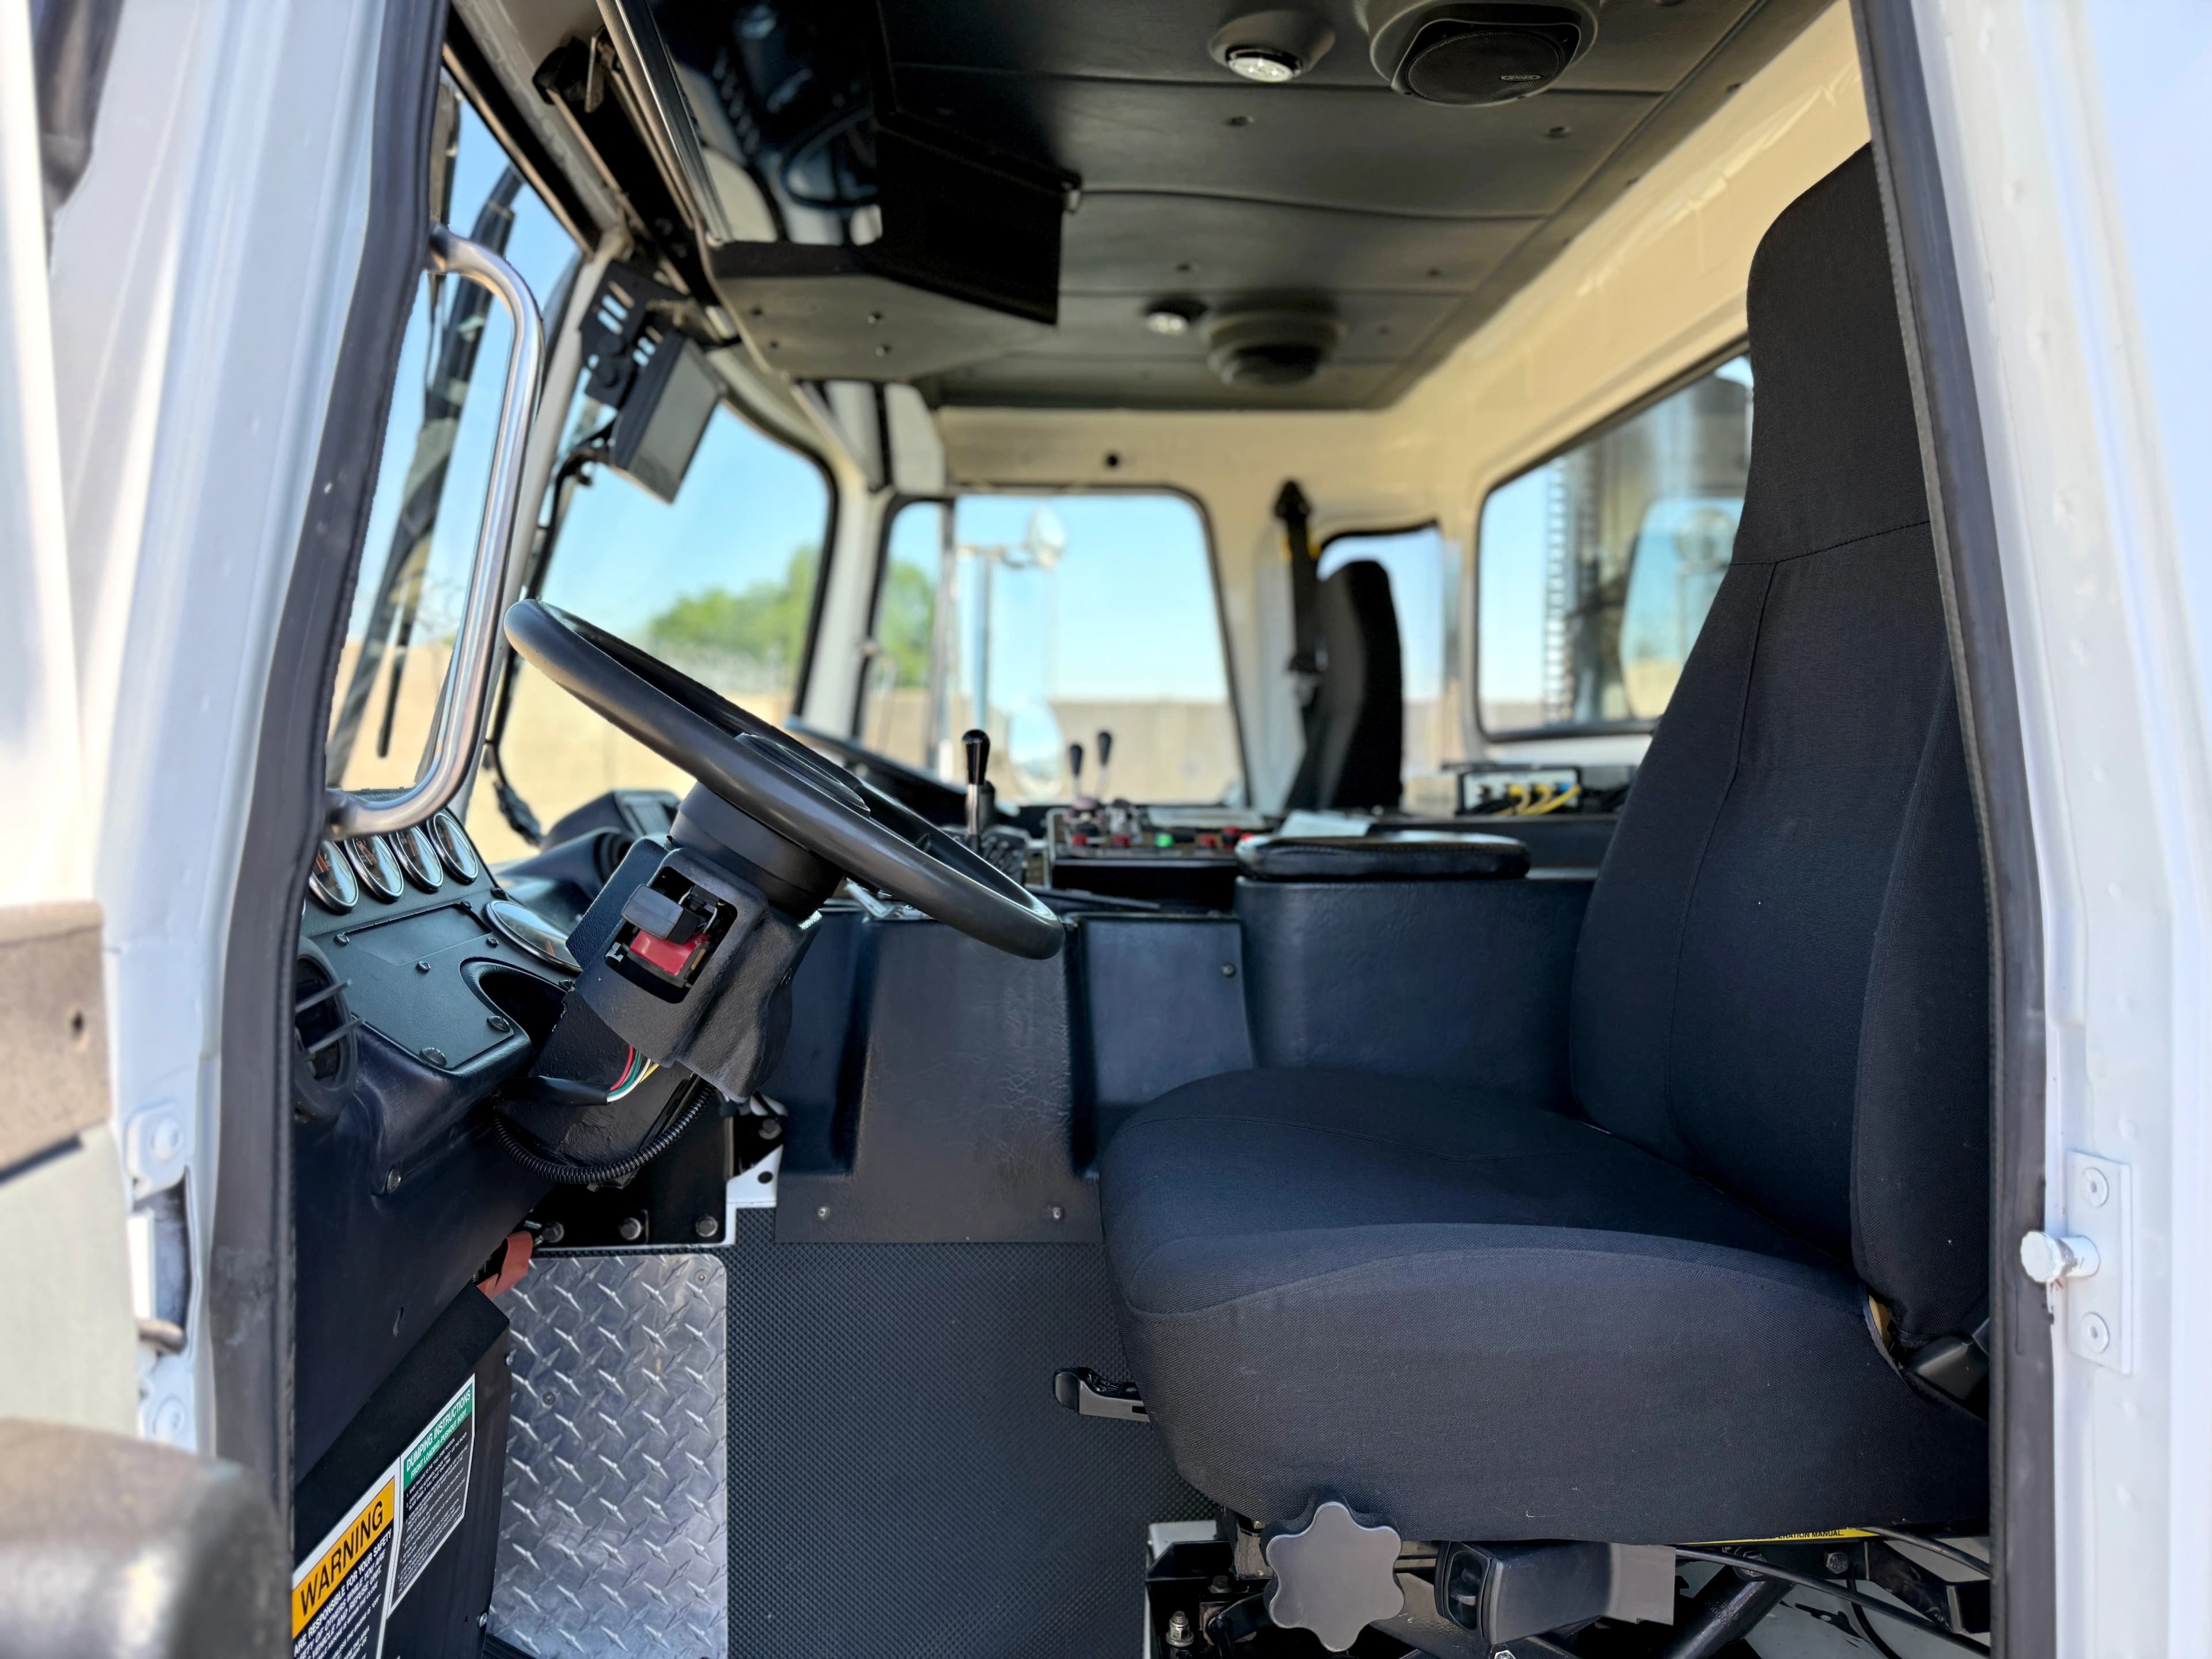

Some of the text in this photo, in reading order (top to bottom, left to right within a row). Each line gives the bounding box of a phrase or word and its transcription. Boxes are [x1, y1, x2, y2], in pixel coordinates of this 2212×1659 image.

[406, 1433, 433, 1472] DUMPING
[434, 1389, 471, 1440] INSTRUCTIONS
[411, 1459, 423, 1479] FRONT
[457, 1408, 467, 1425] BODY
[301, 1501, 382, 1617] WARNING
[1812, 1529, 1844, 1538] MANUAL.
[294, 1634, 307, 1657] ARE
[308, 1585, 346, 1639] RESPONSIBLE
[346, 1570, 358, 1590] FOR
[358, 1552, 373, 1575] YOUR
[373, 1528, 392, 1557] SAFETY
[313, 1624, 336, 1659] VEHICLE
[336, 1608, 348, 1629] AND
[349, 1580, 369, 1612] REFUSE
[315, 1626, 324, 1643] OF
[325, 1599, 346, 1631] OTHERS
[347, 1576, 363, 1603] WHILE
[364, 1563, 375, 1581] YOU
[375, 1548, 386, 1567] ARE
